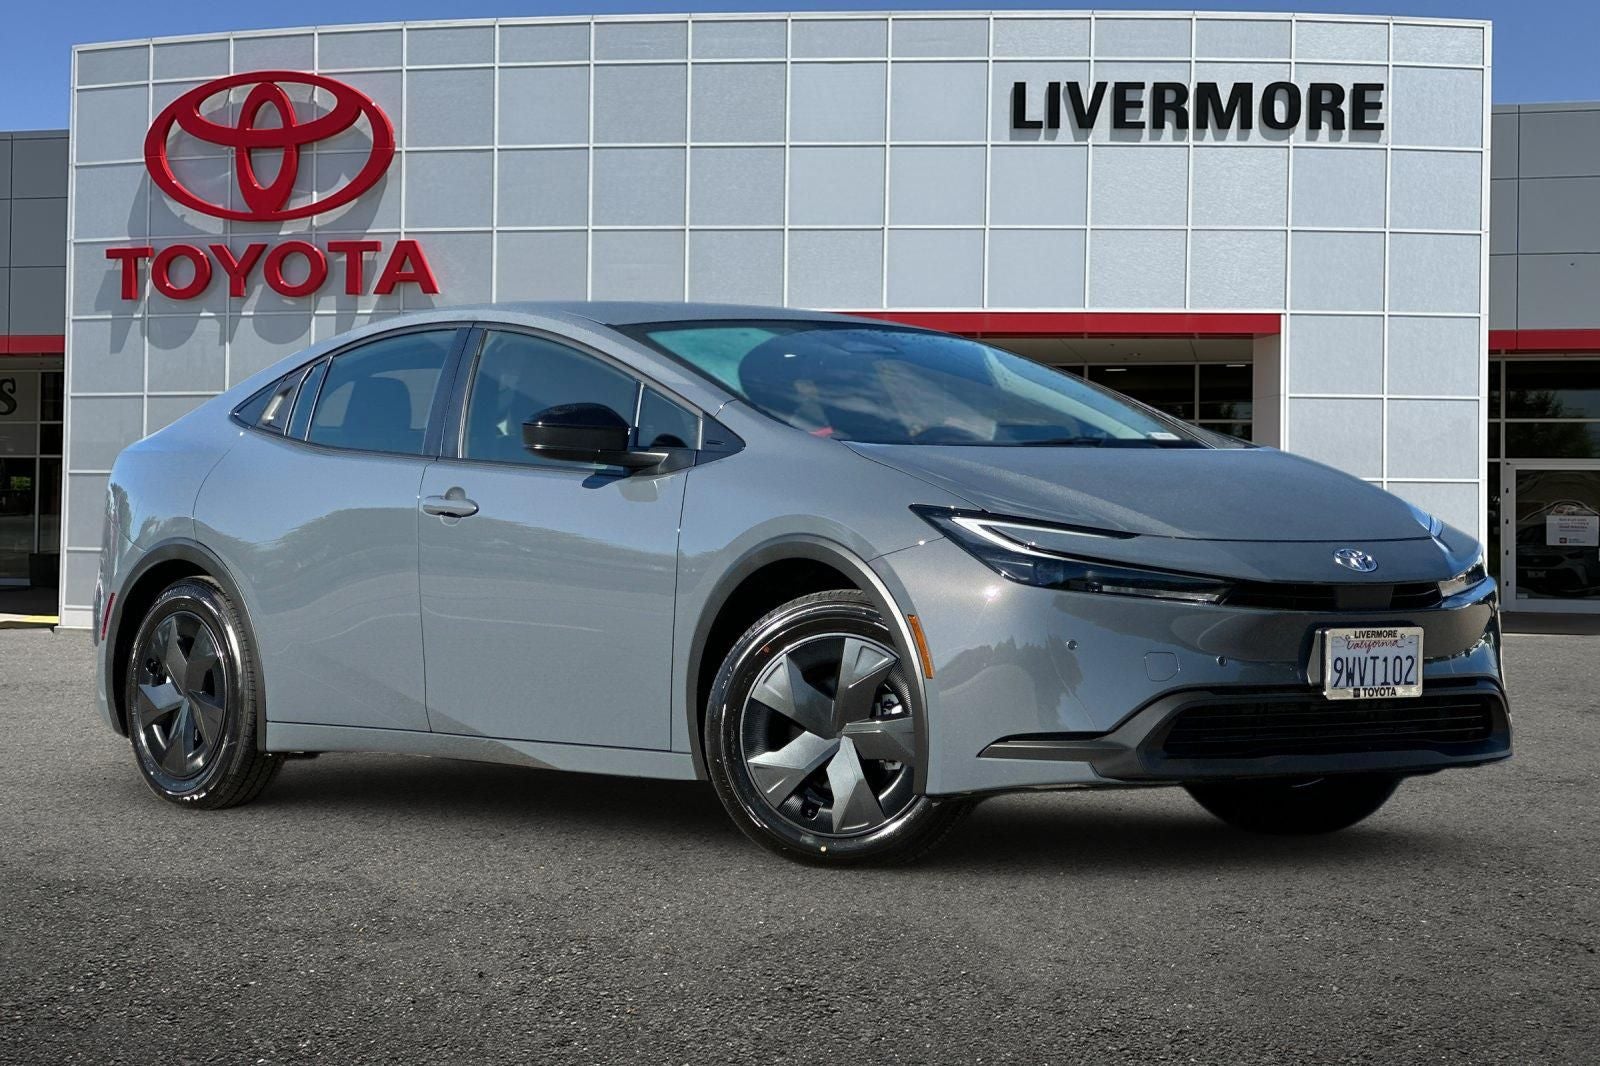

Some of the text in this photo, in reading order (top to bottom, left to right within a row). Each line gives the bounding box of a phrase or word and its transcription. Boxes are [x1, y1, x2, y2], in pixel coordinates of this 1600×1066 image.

[1012, 81, 1385, 131] LIVERMORE
[105, 240, 441, 300] TOYOTA
[1346, 638, 1404, 654] California
[1354, 630, 1398, 639] LIVERMORE
[1333, 655, 1415, 688] 9WVT102
[1362, 687, 1397, 697] TOYOTA
